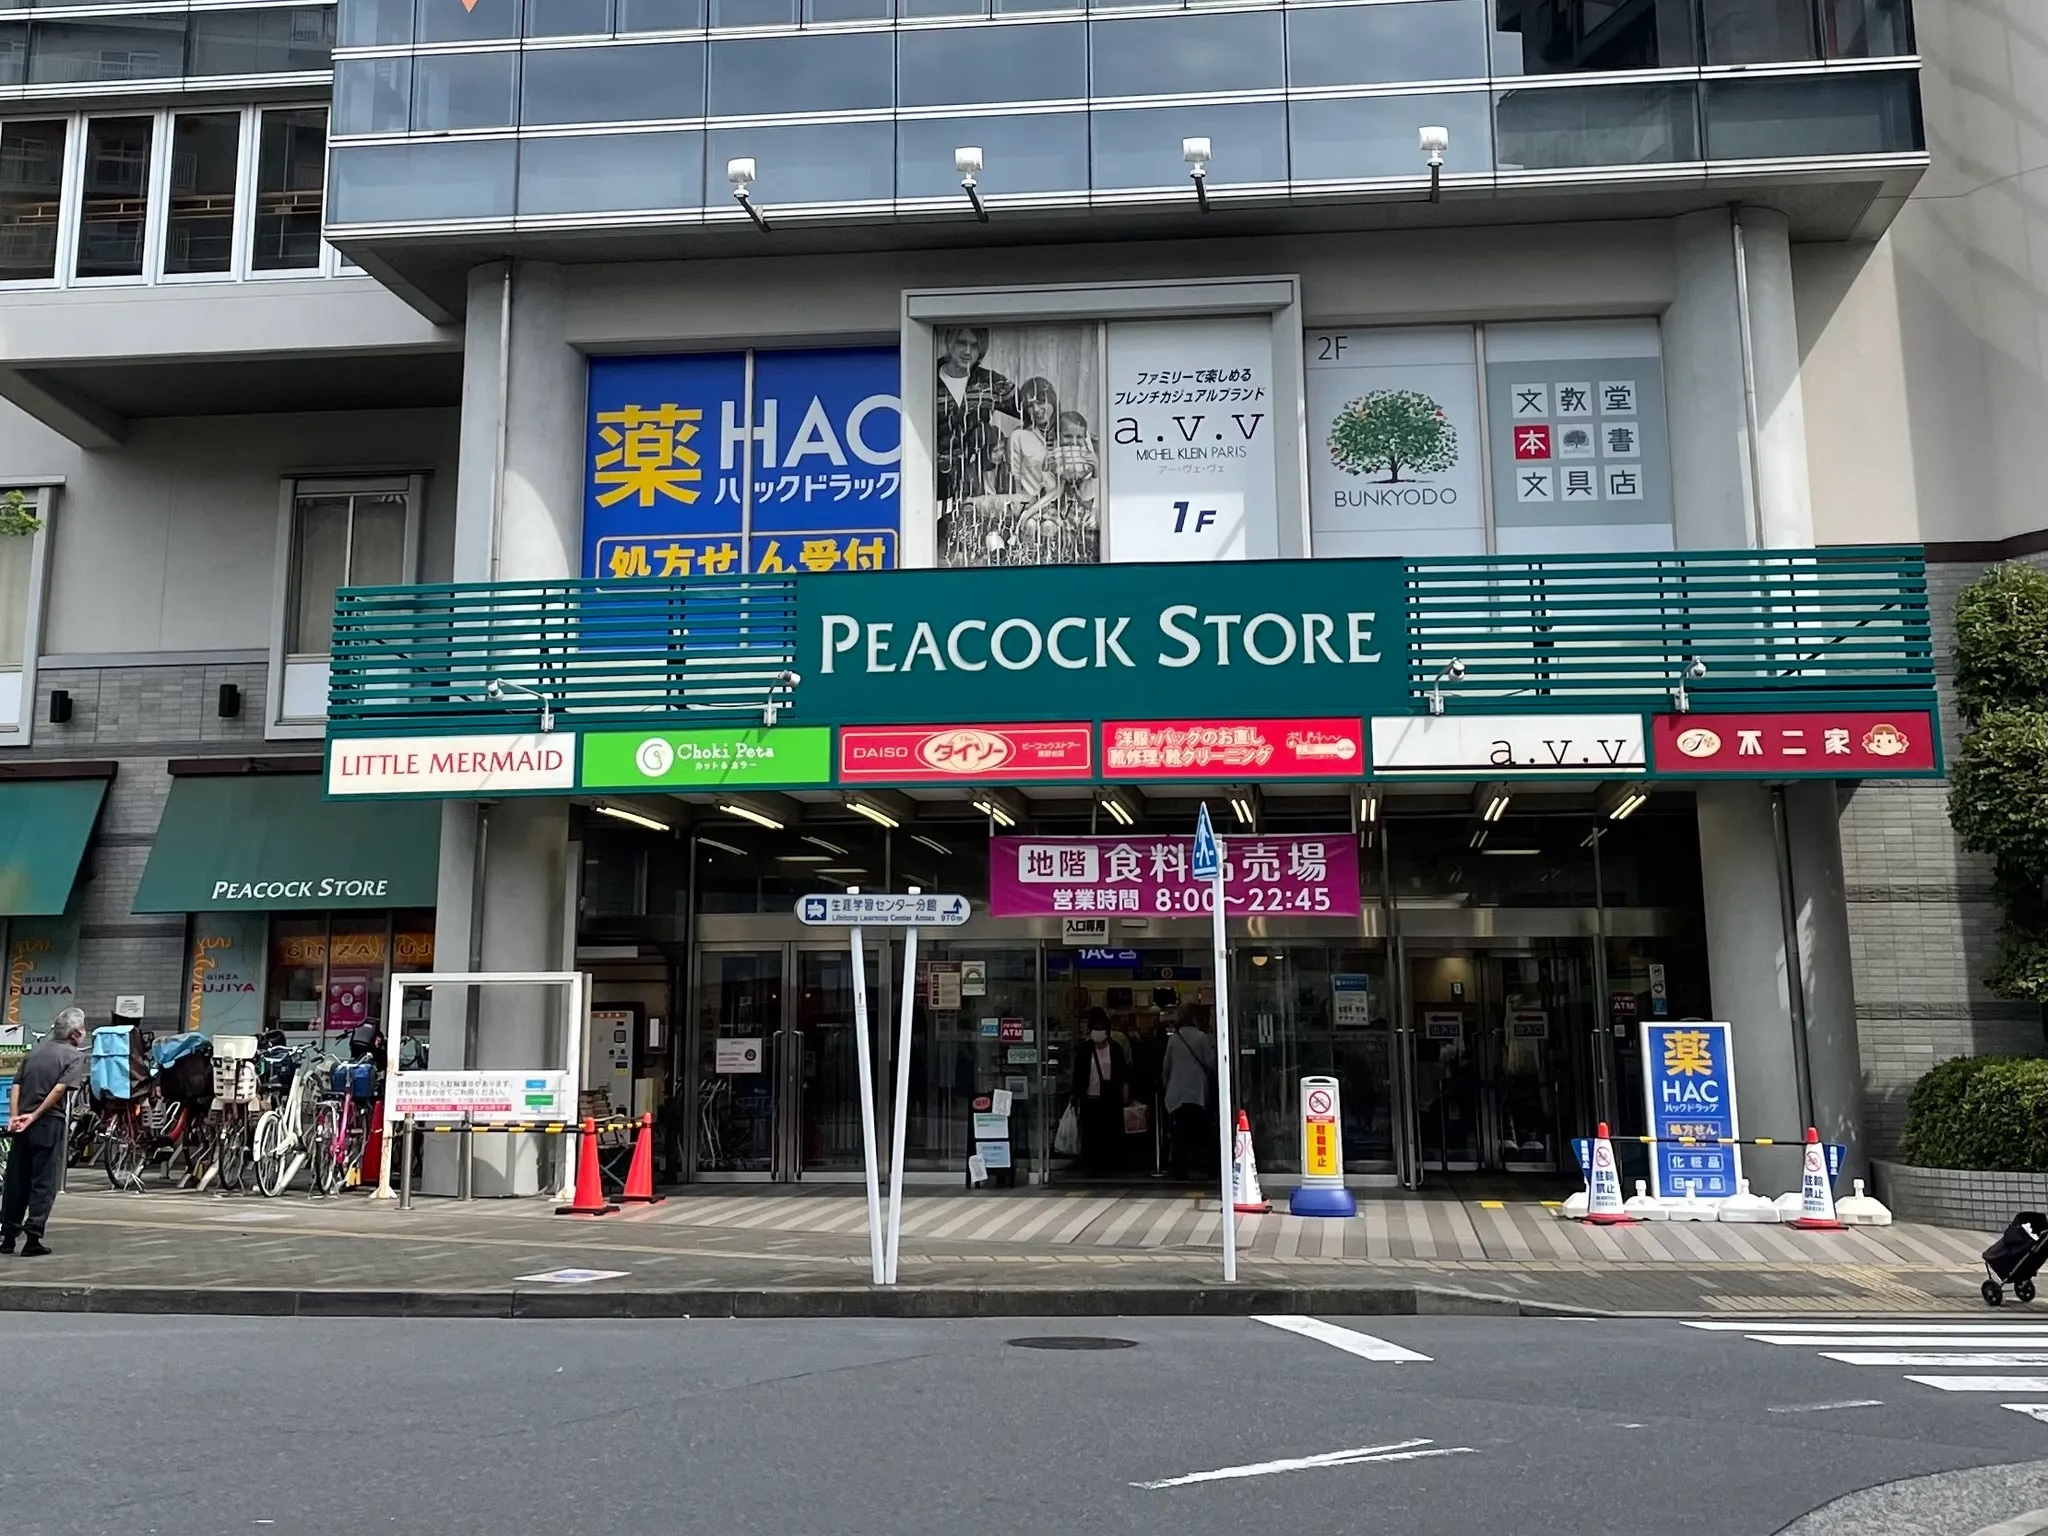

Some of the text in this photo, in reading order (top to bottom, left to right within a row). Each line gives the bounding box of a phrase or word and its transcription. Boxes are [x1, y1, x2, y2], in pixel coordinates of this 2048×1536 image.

[1317, 335, 1348, 360] 2F
[1136, 368, 1252, 385] ファミリーで楽しめる
[1114, 386, 1266, 405] フレンチカジュアルブランド
[1518, 428, 1634, 455] 本 書
[594, 403, 702, 508] 薬
[1136, 446, 1247, 461] MICHEL KLEIN PARIS
[1333, 487, 1457, 507] BUNKYODO
[1173, 501, 1217, 533] 1F
[820, 604, 1382, 674] PEACOCK STORE
[677, 743, 775, 760] Choki Peta
[934, 741, 1004, 762] ダイソー
[1737, 728, 1851, 755] 不二家
[341, 750, 564, 776] LITTLE MERMAID
[853, 746, 908, 759] DAISO
[1027, 849, 1087, 878] 地階
[212, 877, 388, 899] PEACOCK STORE
[1053, 889, 1140, 911] 営業時間
[832, 914, 858, 922] Lifelong
[860, 914, 889, 922] Learning
[890, 914, 912, 922] Center
[192, 982, 256, 993] FUJIYA
[207, 973, 239, 981] GINZA
[9, 986, 73, 996] FUJIYA
[1614, 1002, 1635, 1010] ATM
[1003, 1029, 1022, 1037] ATM
[1663, 1030, 1712, 1076] 薬
[1662, 1080, 1719, 1103] HAC
